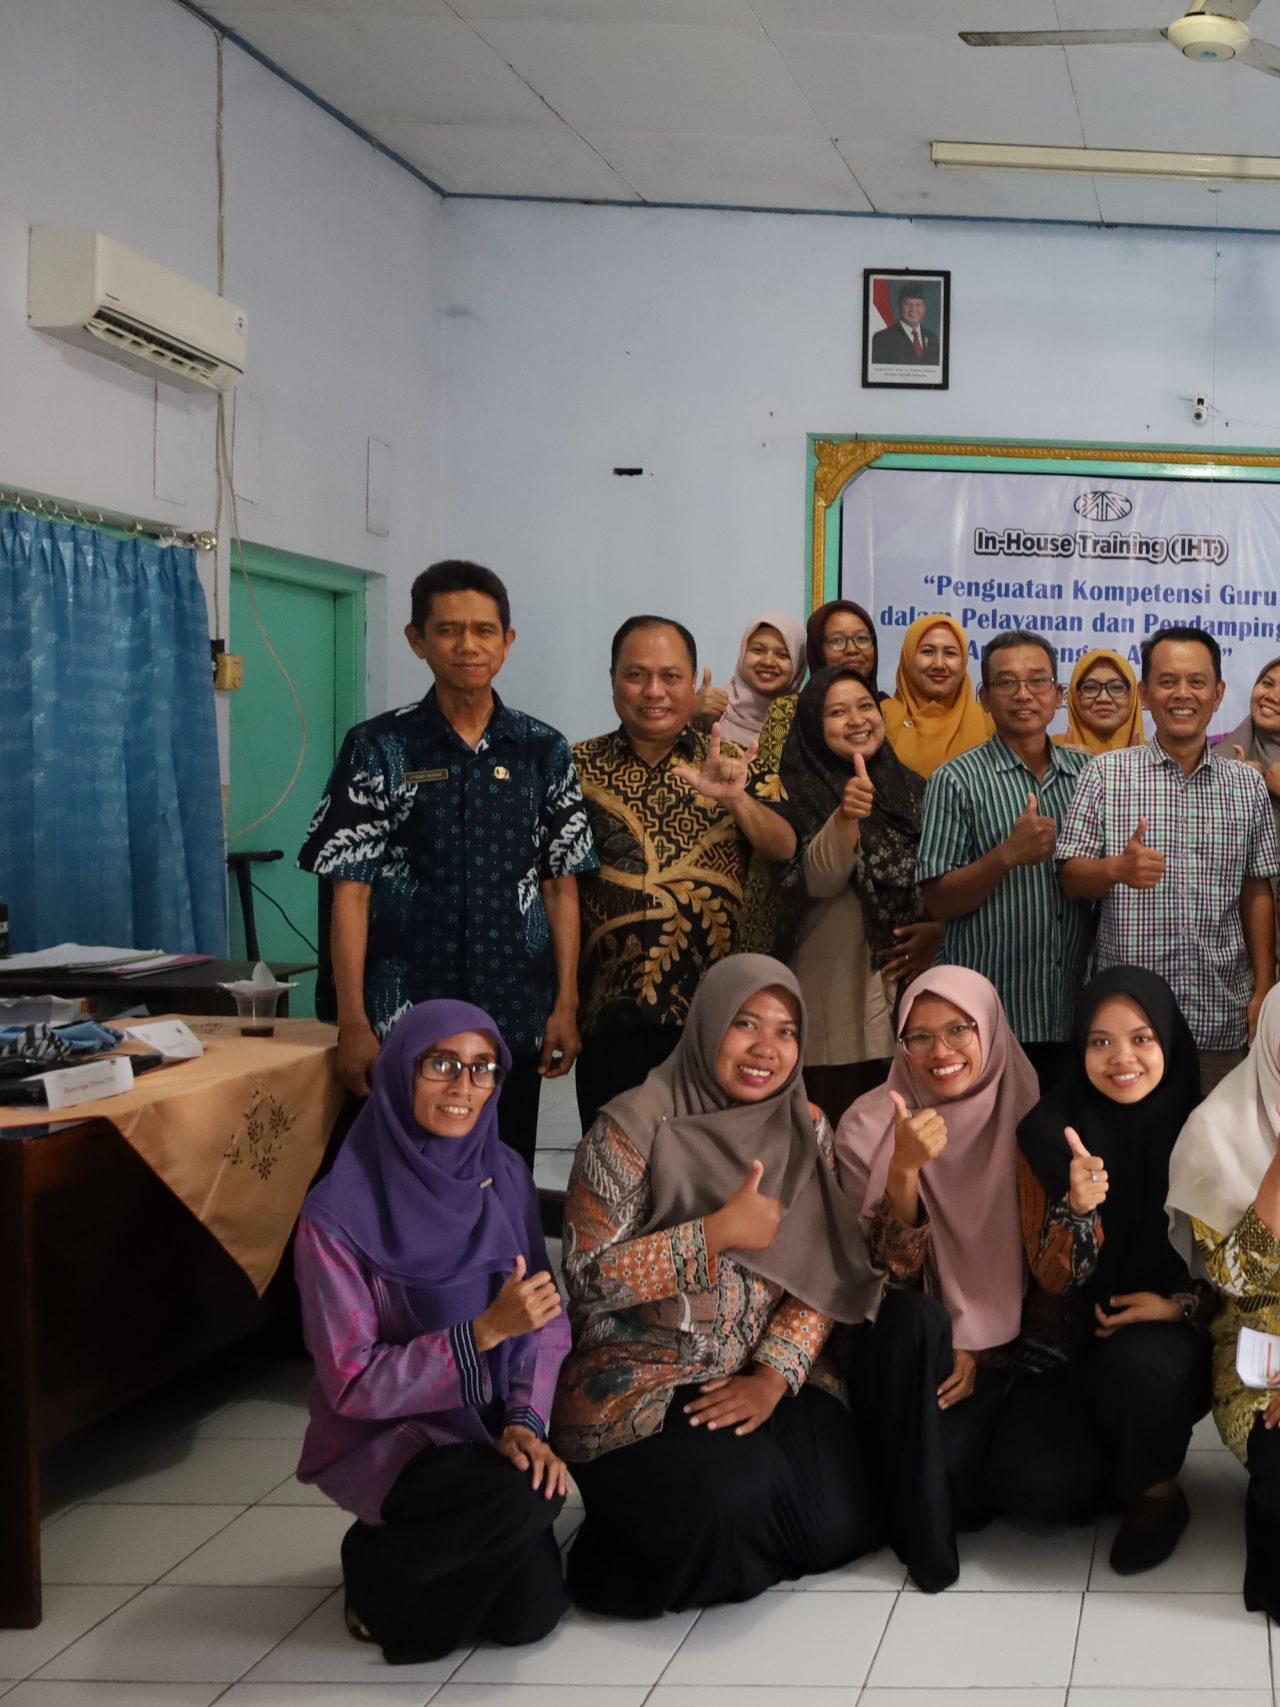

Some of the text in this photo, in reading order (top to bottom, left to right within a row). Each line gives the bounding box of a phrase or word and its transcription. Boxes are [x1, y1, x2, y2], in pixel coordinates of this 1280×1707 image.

[975, 529, 1228, 564] In-House Training (IHT)
[1073, 579, 1211, 606] Kompetensi
[1219, 584, 1277, 606] Guru
[881, 605, 951, 626] dal
[961, 608, 1083, 632] Pelayanan
[1092, 612, 1135, 633] dan
